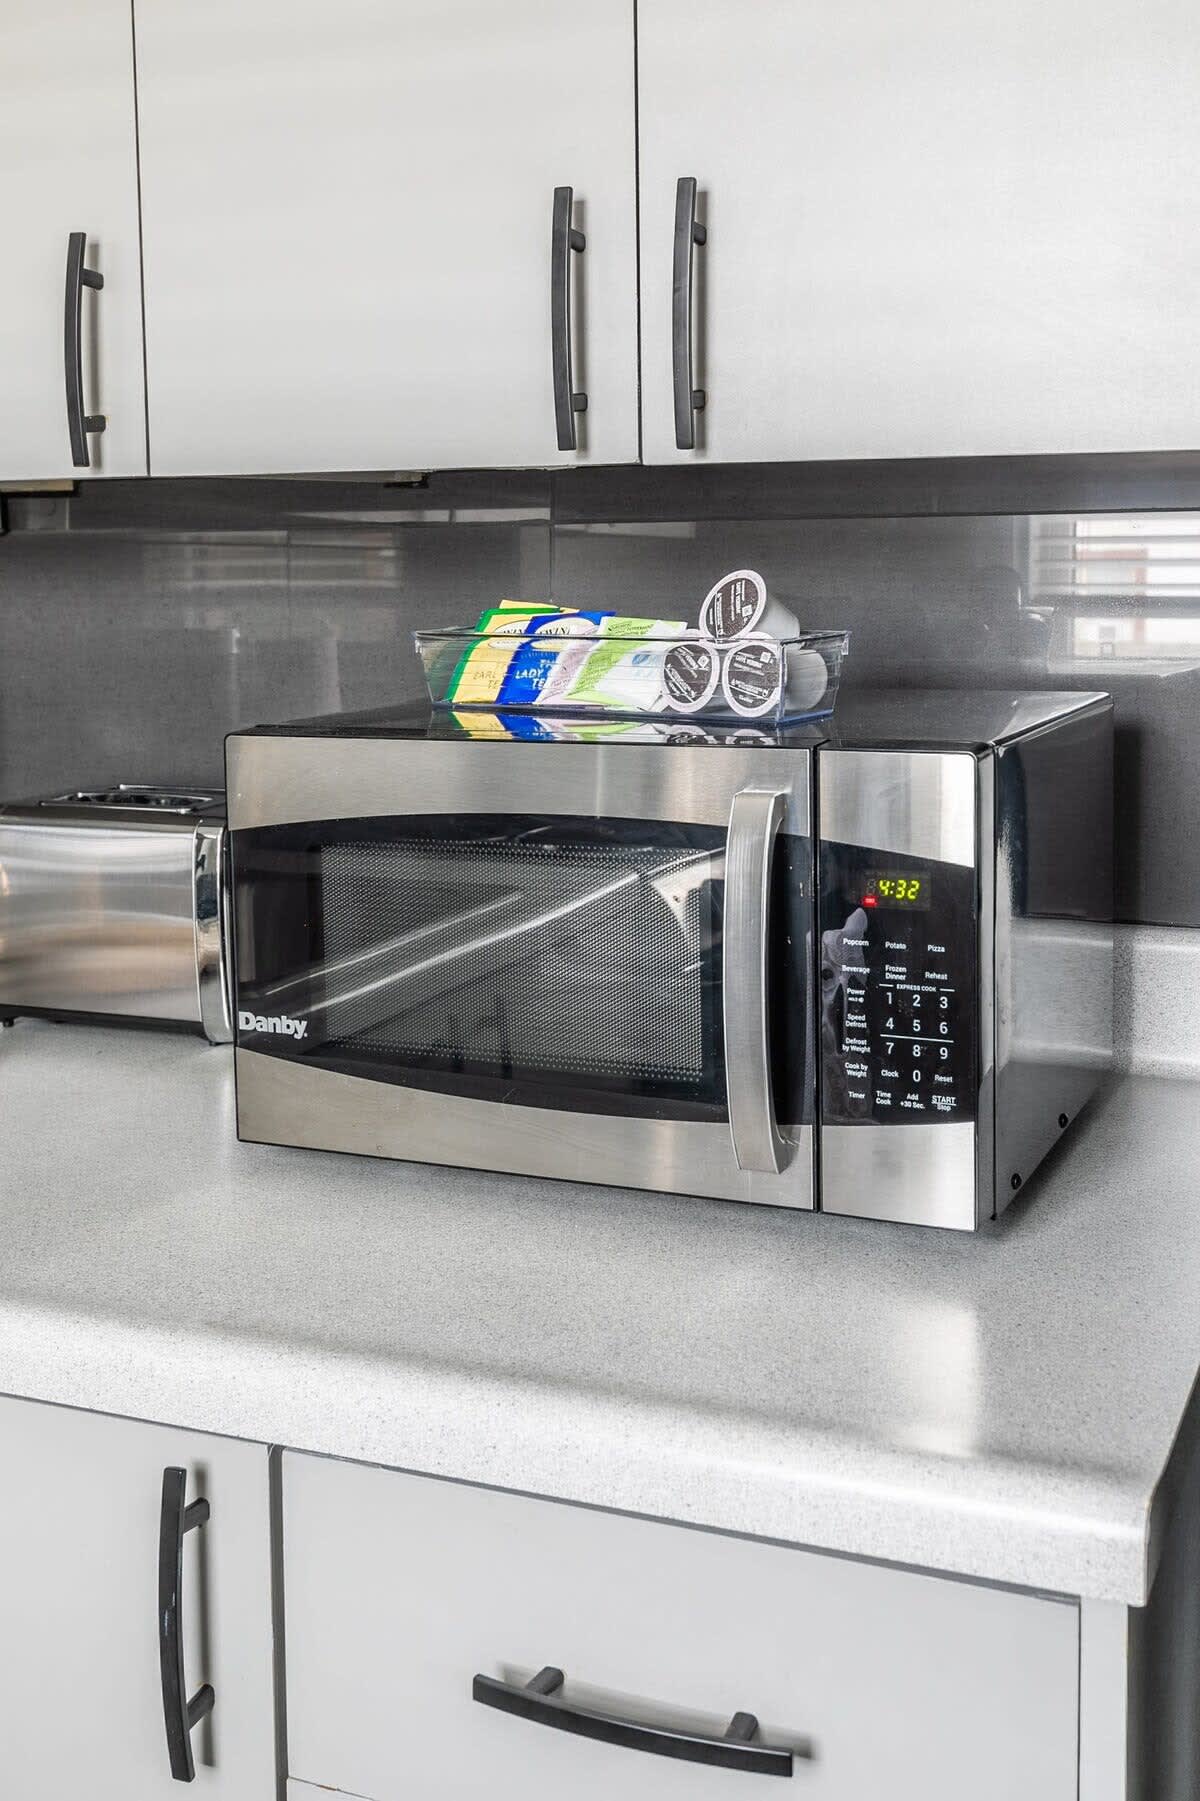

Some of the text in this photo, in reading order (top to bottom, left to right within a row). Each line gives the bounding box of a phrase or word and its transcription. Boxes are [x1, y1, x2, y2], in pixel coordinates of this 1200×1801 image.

[515, 668, 544, 679] LADY
[488, 680, 498, 689] TE
[531, 679, 546, 690] TE
[879, 879, 920, 900] 4:32
[843, 938, 869, 947] Popcorn
[885, 942, 907, 950] Potato
[927, 945, 945, 953] Pizza
[842, 965, 870, 974] Beverage
[885, 965, 907, 973] Frozen
[925, 972, 948, 980] Reheat
[847, 988, 865, 996] Power
[886, 992, 892, 1004] 1
[912, 994, 921, 1007] 2
[940, 996, 948, 1009] 3
[847, 1013, 866, 1022] Speed
[845, 1020, 867, 1028] Defrost
[886, 1017, 894, 1030] 4
[912, 1020, 921, 1032] 5
[940, 1022, 948, 1034] 6
[845, 1037, 867, 1045] Defrost
[842, 1044, 870, 1054] by Weight
[886, 1042, 894, 1054] 7
[912, 1044, 921, 1057] 8
[940, 1047, 948, 1060] 9
[860, 1063, 868, 1072] by
[846, 1070, 867, 1078] Weight
[881, 1069, 899, 1078] Clock
[912, 1070, 921, 1082] 0
[934, 1074, 953, 1083] Reset
[848, 1091, 866, 1099] Timer
[876, 1090, 892, 1098] Time
[906, 1093, 919, 1101] Add
[876, 1098, 892, 1106] Cook
[932, 1095, 956, 1104] START
[936, 1104, 952, 1112] Stop
